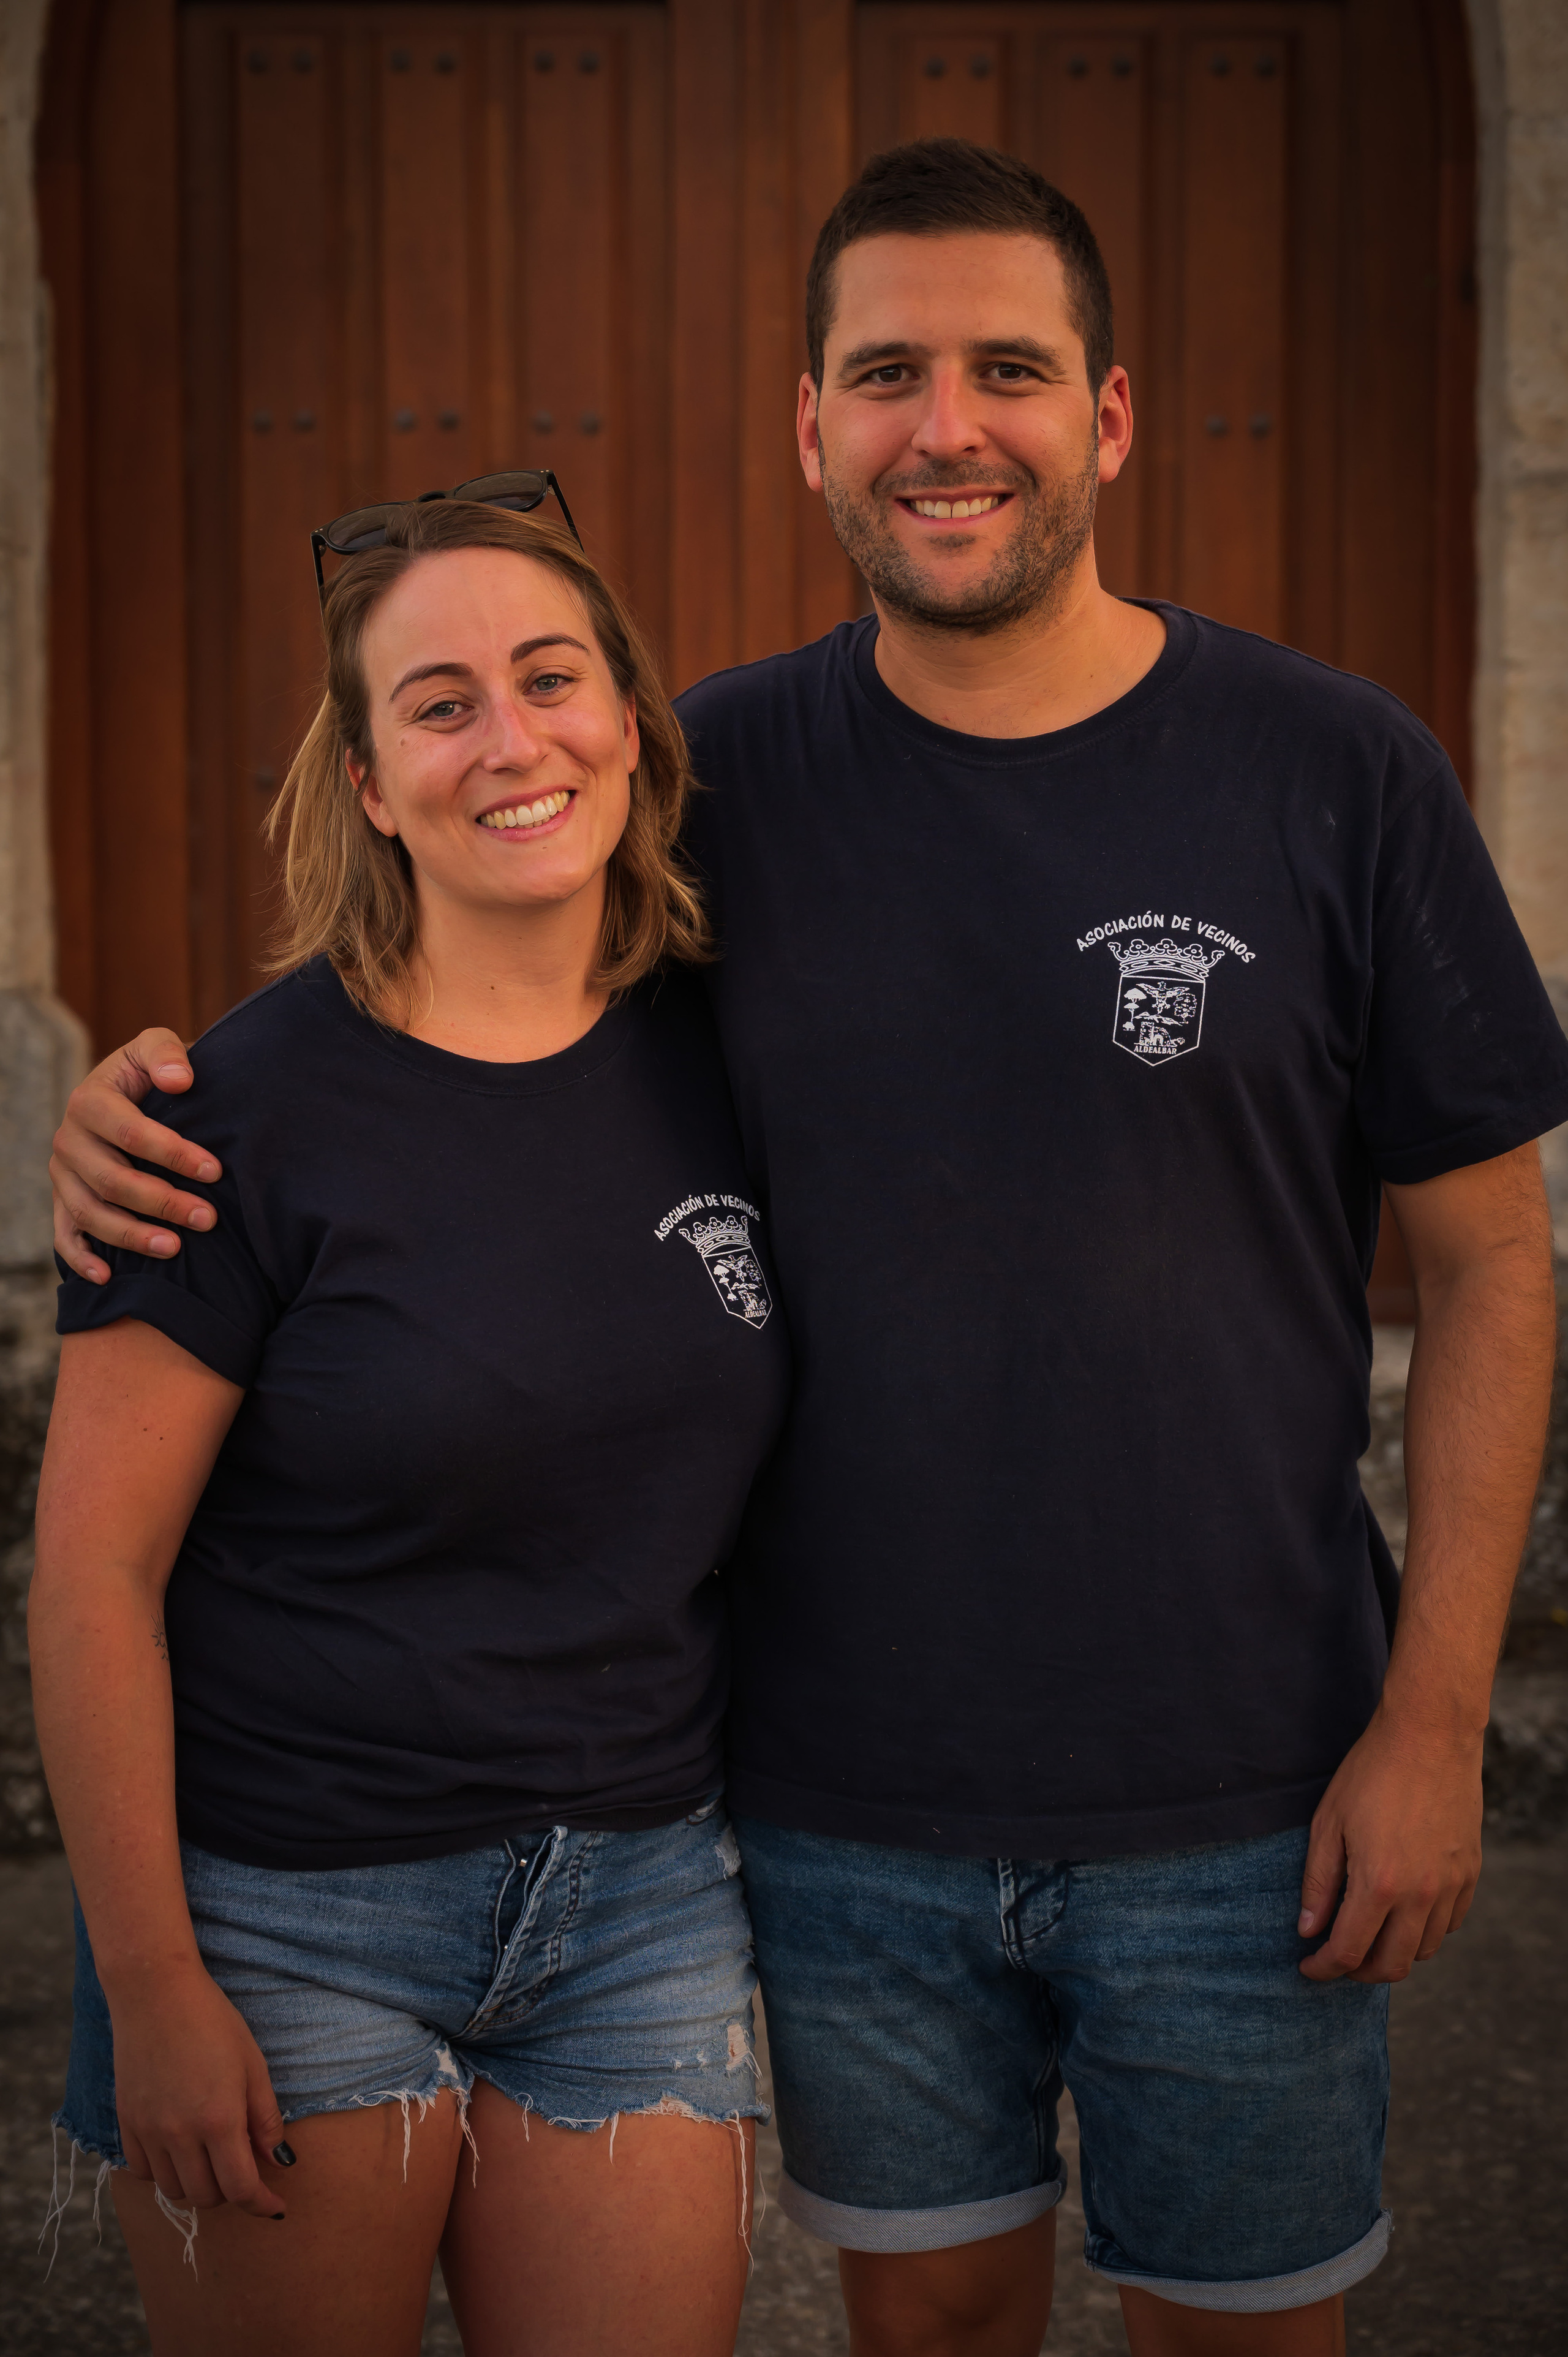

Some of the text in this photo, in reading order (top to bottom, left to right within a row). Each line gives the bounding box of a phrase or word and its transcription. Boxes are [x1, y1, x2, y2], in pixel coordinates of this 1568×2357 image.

[1076, 910, 1256, 963] ASOCIACIÓN DE VECINOS
[1134, 1045, 1177, 1054] ALDEALBAR
[654, 1194, 760, 1241] ASOCIACIÓN DE VECINOS
